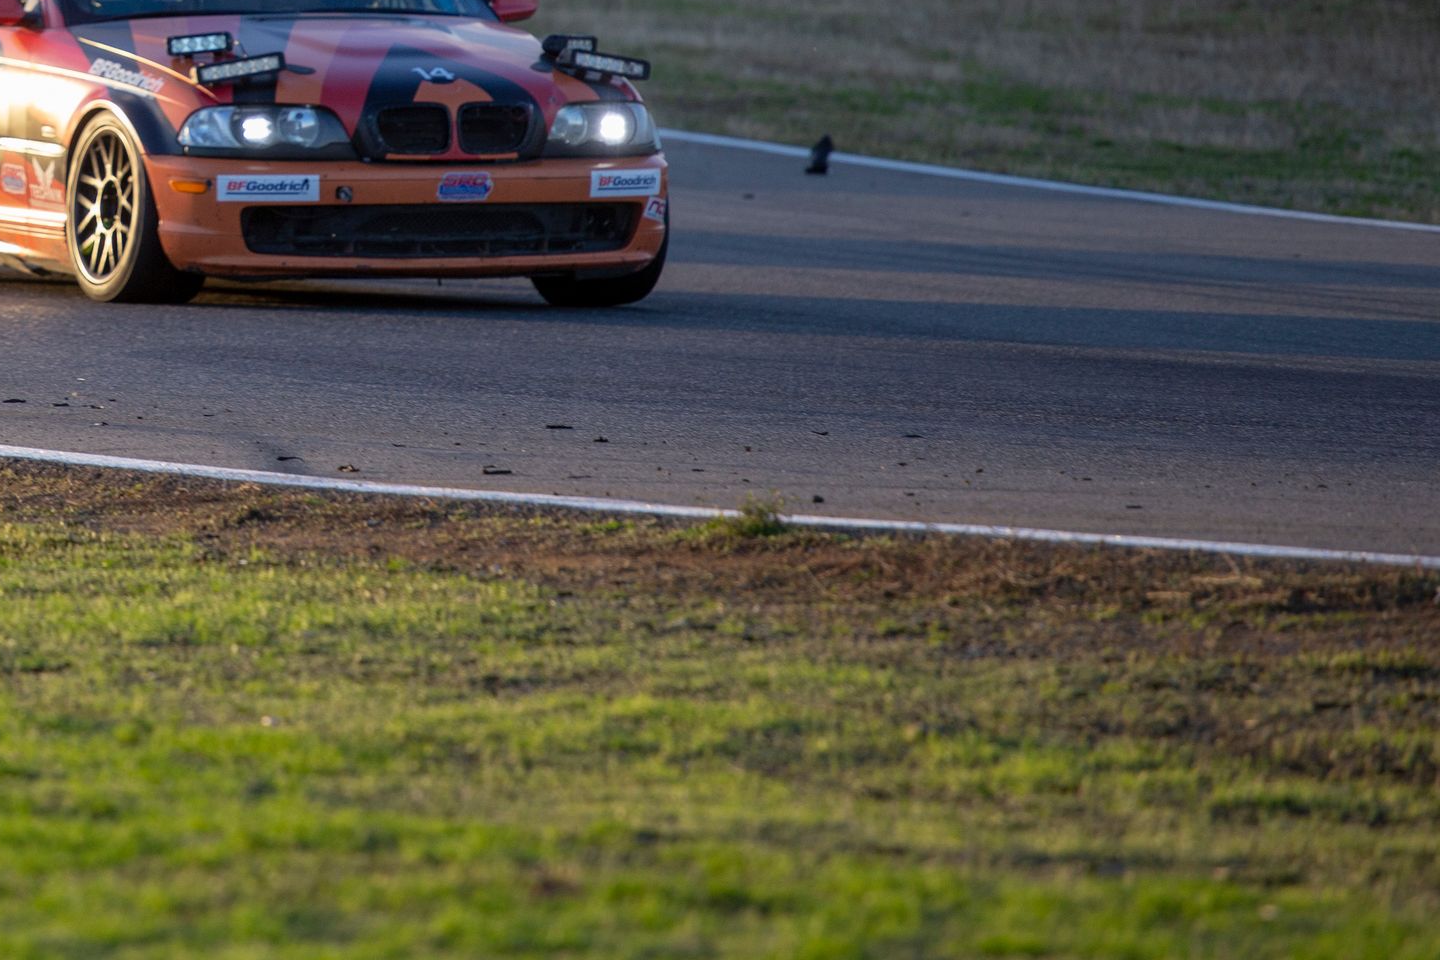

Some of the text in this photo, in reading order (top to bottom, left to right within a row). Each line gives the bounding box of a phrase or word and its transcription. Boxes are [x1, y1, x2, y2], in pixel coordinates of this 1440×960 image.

[411, 66, 455, 80] 14
[226, 178, 310, 191] BFGoodrich
[599, 174, 657, 187] BFGoodrich
